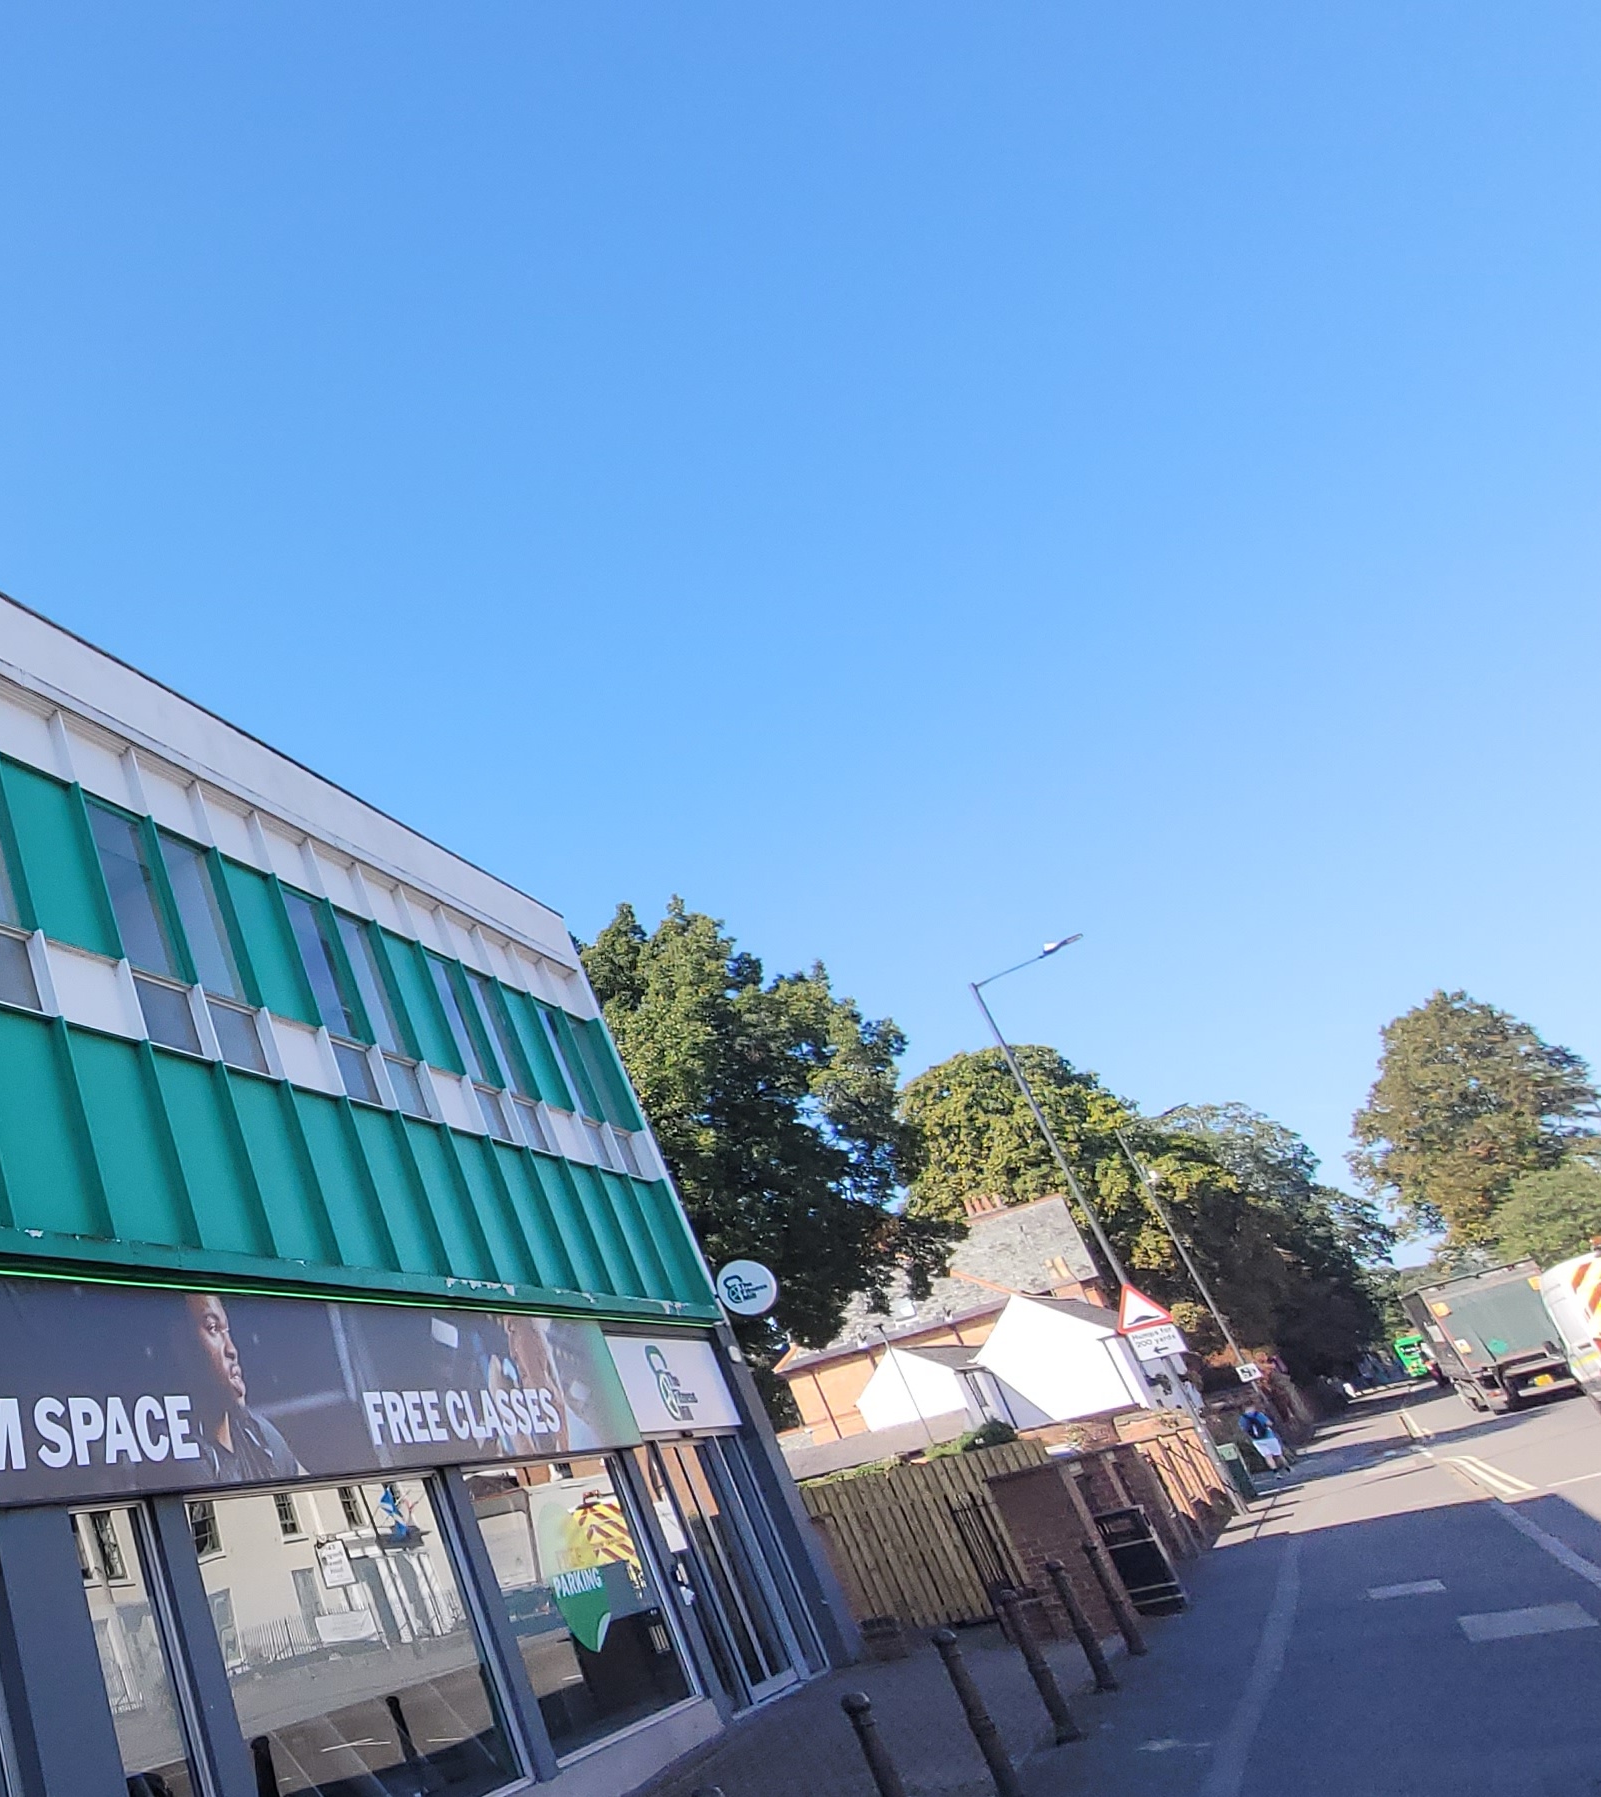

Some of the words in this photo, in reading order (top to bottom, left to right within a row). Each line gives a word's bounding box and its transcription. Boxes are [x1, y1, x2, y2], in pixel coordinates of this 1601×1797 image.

[1135, 1339, 1152, 1348] 200
[34, 1395, 200, 1469] SPACE
[362, 1390, 449, 1445] FREE
[445, 1388, 561, 1440] CLASSES
[553, 1567, 603, 1599] PARKING
